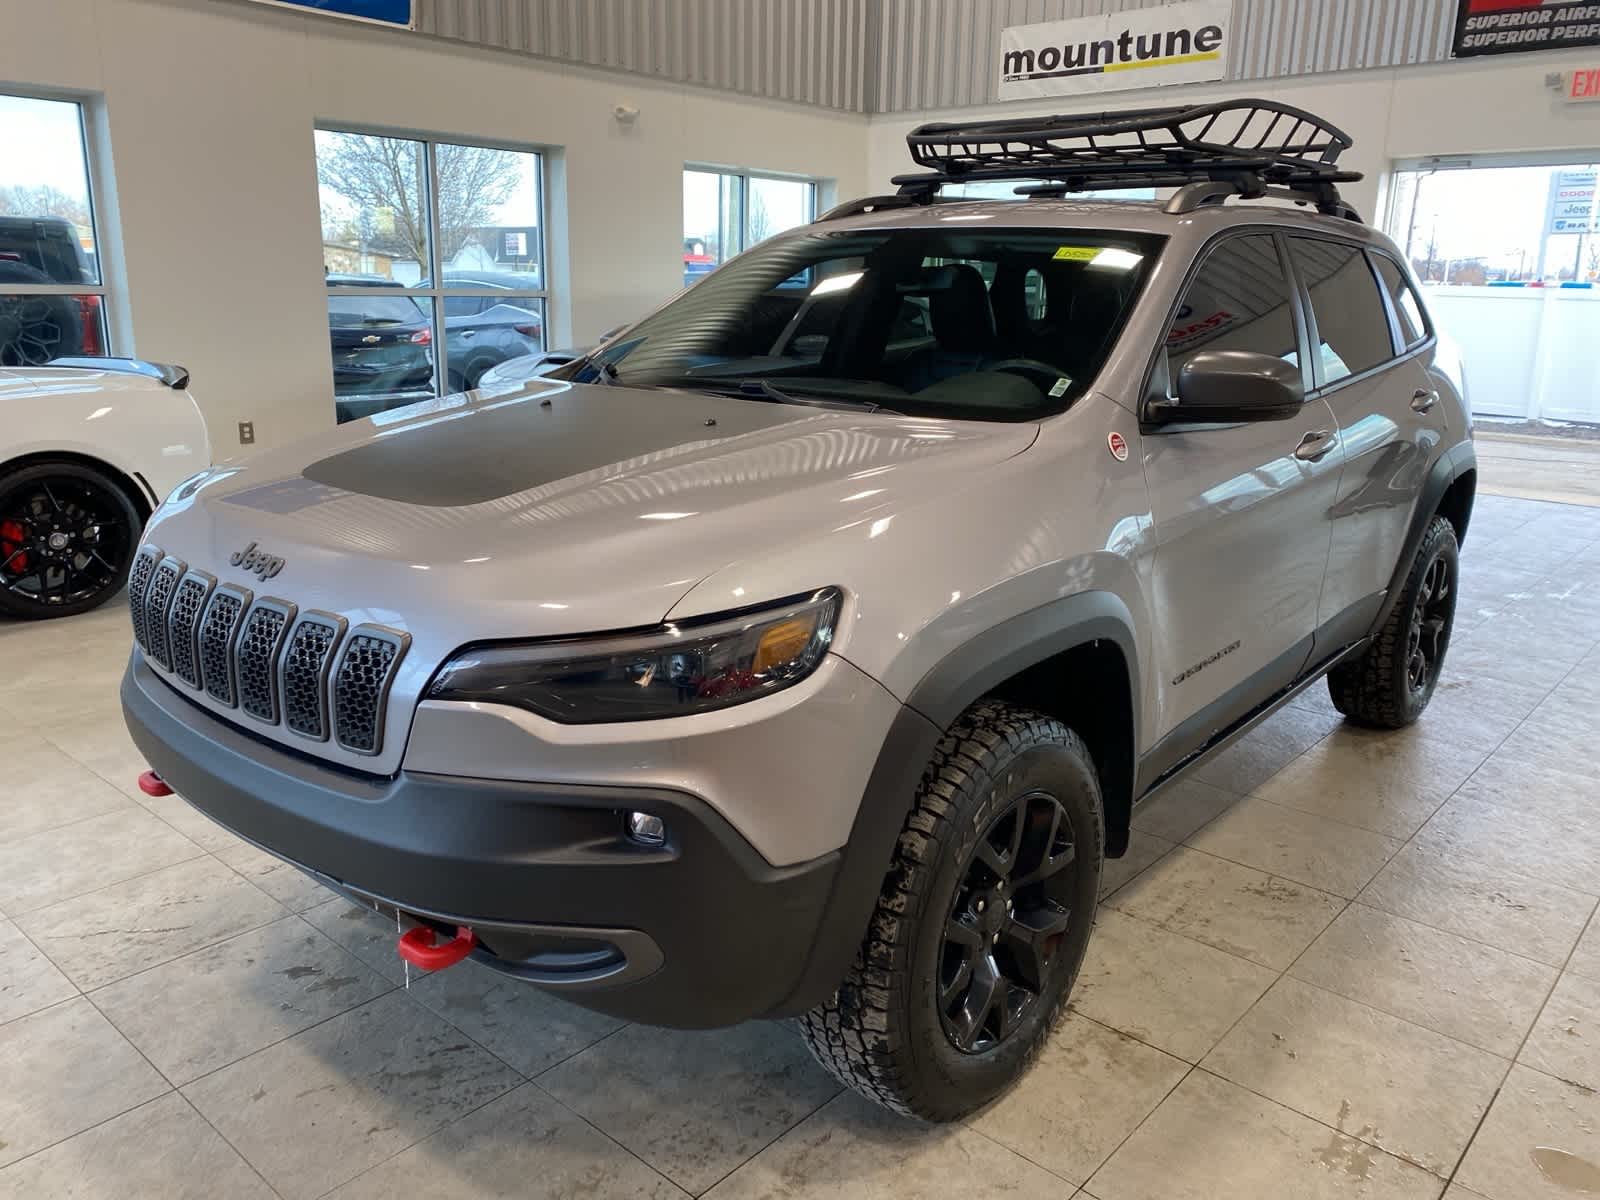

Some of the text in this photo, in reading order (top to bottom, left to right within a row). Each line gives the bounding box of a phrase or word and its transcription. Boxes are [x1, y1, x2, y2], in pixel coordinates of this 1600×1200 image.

[1462, 23, 1600, 48] SUPERIOR PERF
[1465, 9, 1553, 30] SUPERIOR
[1003, 25, 1223, 75] mountune
[230, 542, 286, 583] Jeep
